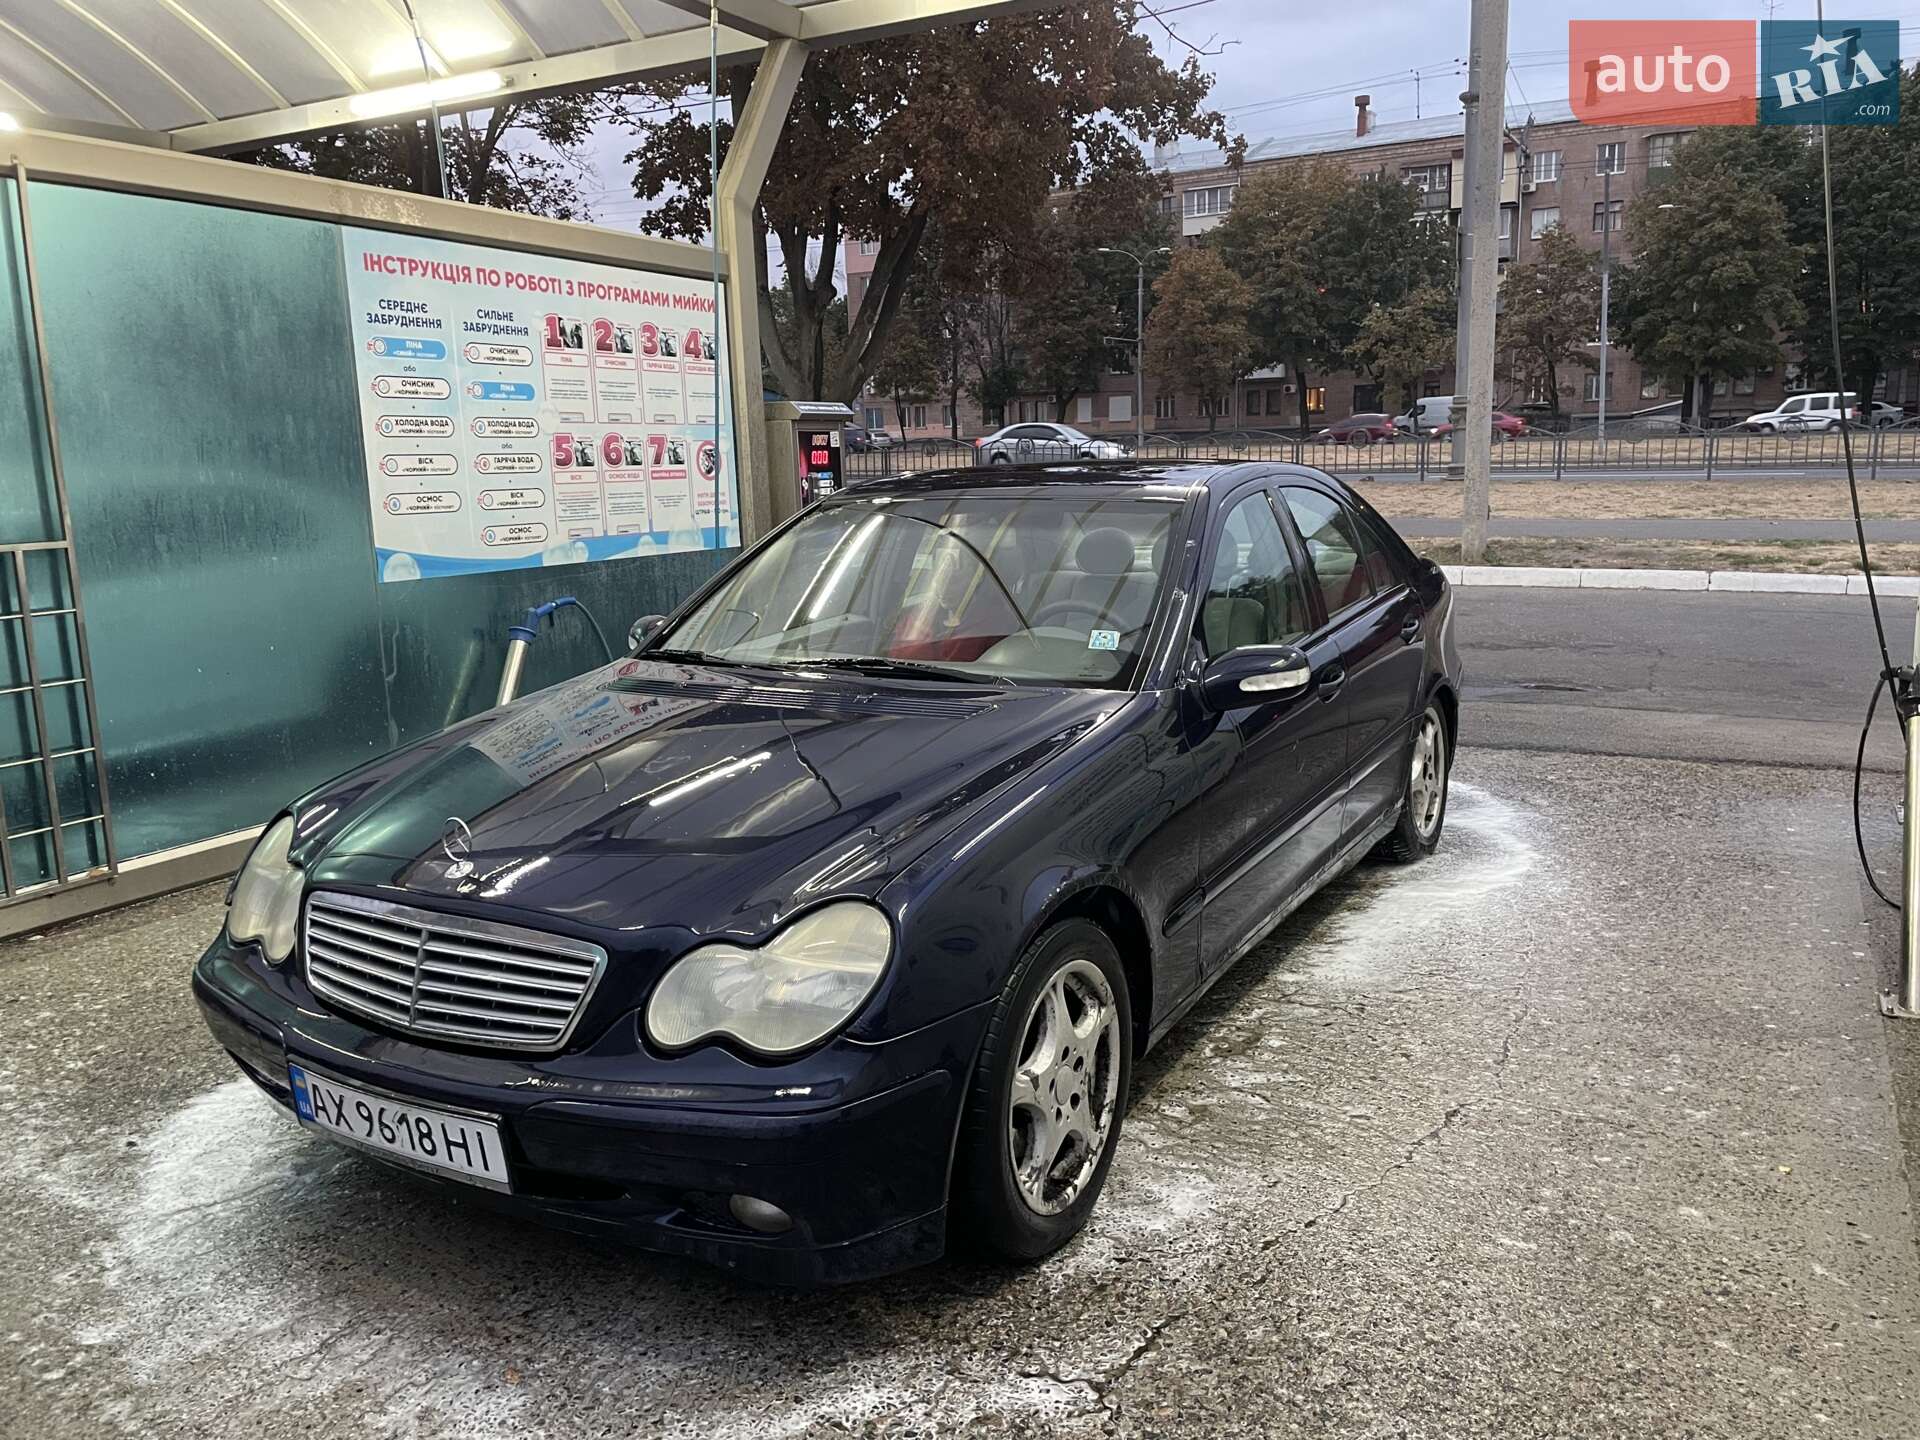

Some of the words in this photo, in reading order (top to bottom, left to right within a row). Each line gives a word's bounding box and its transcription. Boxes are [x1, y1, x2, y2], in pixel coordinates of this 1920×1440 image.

[363, 252, 472, 284] ІНСТРУКЦІЯ
[476, 267, 500, 287] ПО
[505, 271, 562, 295] РОБОТІ
[578, 281, 670, 308] ПРОГРАМАМИ
[673, 293, 715, 313] МИЙКИ
[378, 298, 428, 314] СЕРЕДНЄ
[366, 313, 442, 329] ЗАБРУДНЕННЯ
[477, 309, 514, 322] СИЛЬНЕ
[463, 321, 529, 337] ЗАБРУДНЕННЯ
[544, 314, 563, 350] 1
[593, 318, 615, 354] 2
[405, 340, 423, 349] ПІНА
[640, 322, 660, 357] 3
[683, 328, 703, 360] 4
[489, 347, 519, 356] ОЧИСНИК
[401, 379, 435, 388] ОЧИСНИК
[394, 418, 430, 427] ХОЛОДНА
[430, 419, 449, 428] ВОДА
[487, 420, 517, 428] ХОЛОДНА
[518, 420, 535, 428] ВОДА
[554, 433, 574, 469] 5
[602, 433, 624, 468] 6
[647, 434, 667, 467] 7
[418, 457, 434, 465] ВІСК
[493, 456, 517, 464] ГАРЯЧА
[517, 456, 534, 464] ВОДА
[416, 495, 443, 503] ОСМОС
[509, 526, 533, 534] ОСМОС
[300, 1101, 312, 1115] UA
[312, 1083, 354, 1132] AX
[356, 1100, 437, 1157] 9618
[441, 1121, 490, 1172] HI
